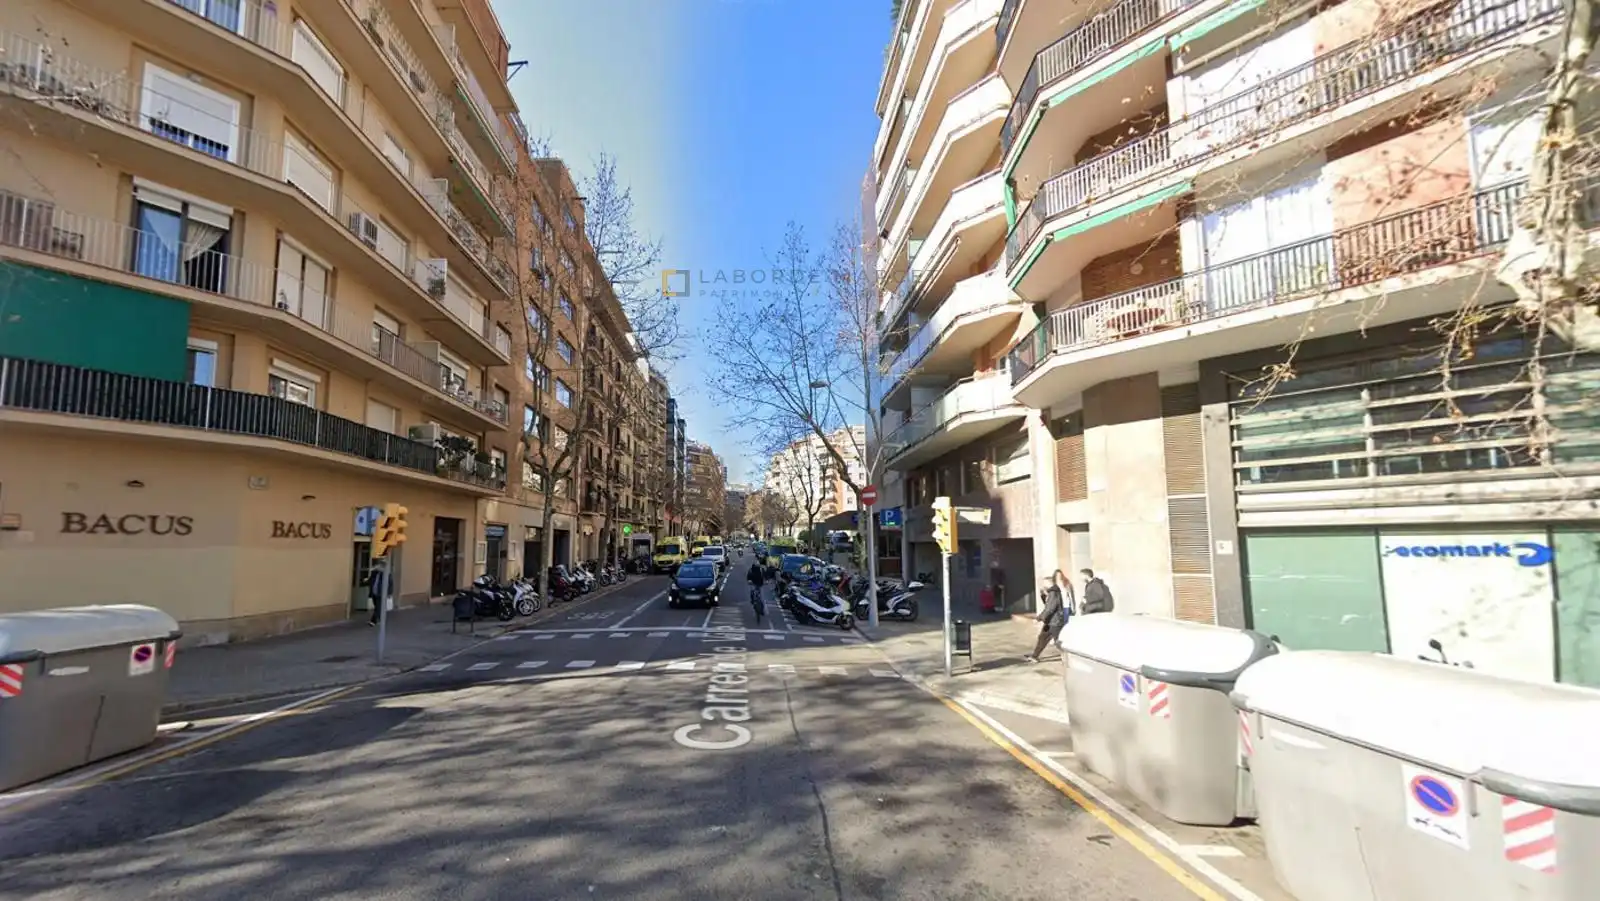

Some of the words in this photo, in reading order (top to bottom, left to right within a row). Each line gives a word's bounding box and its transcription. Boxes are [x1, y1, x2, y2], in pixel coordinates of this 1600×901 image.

[60, 512, 194, 536] BACUS
[884, 510, 894, 522] P
[271, 520, 332, 539] BACUS
